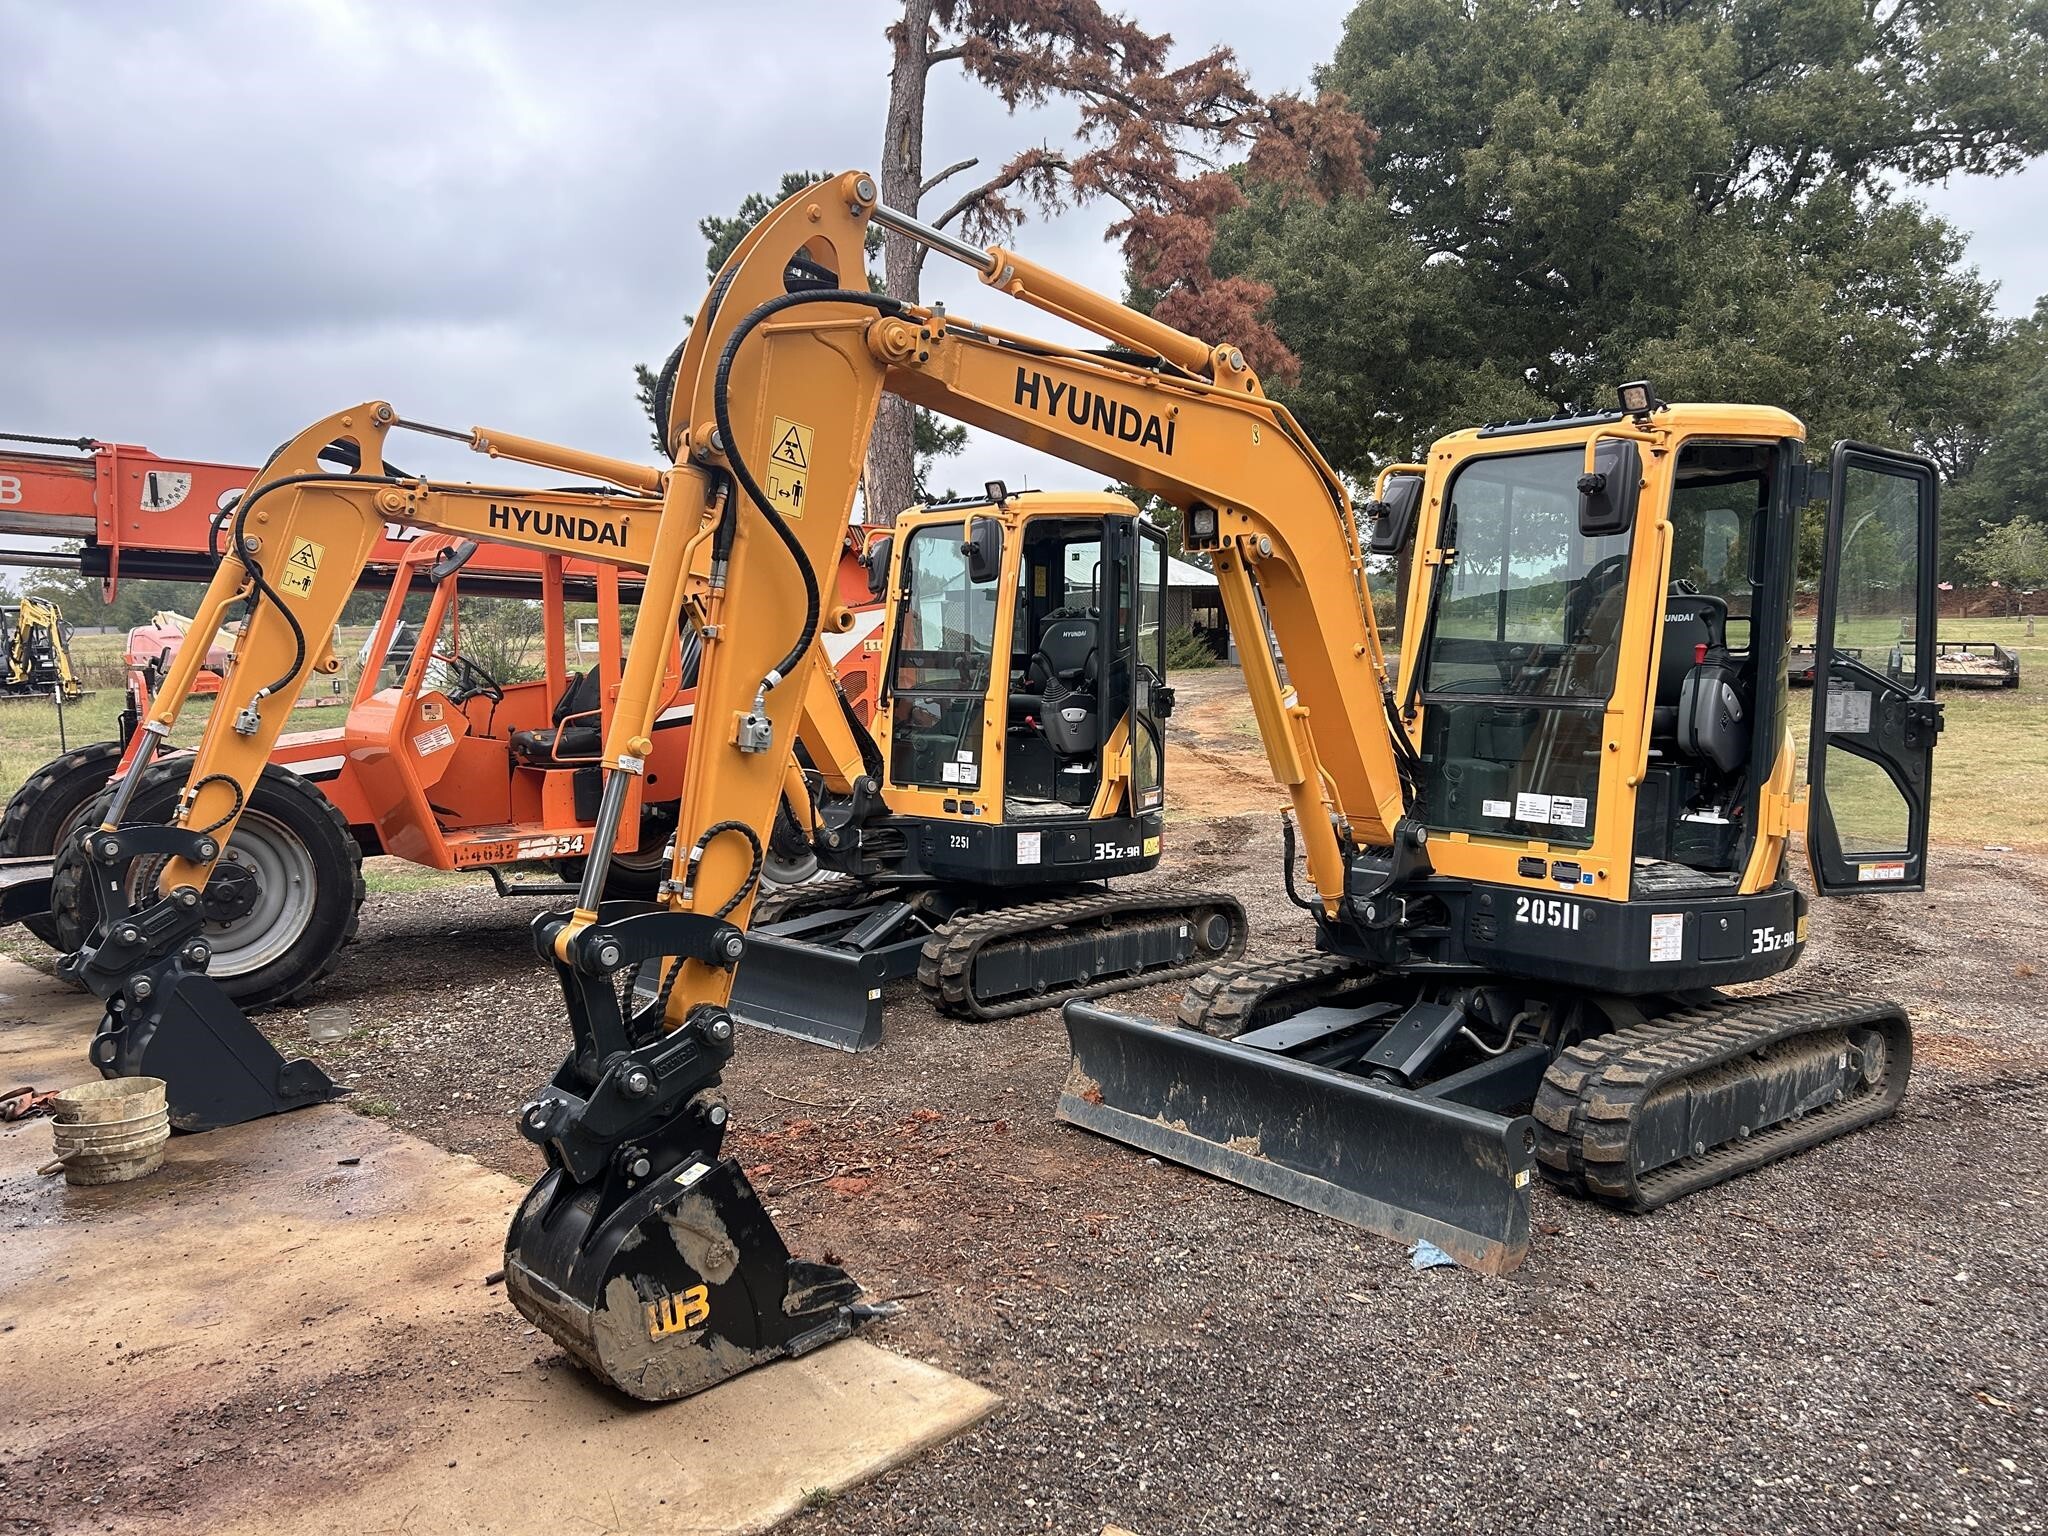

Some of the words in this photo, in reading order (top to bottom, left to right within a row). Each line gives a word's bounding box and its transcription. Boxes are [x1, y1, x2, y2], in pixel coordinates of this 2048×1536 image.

[1014, 366, 1175, 456] HYUNDAI
[489, 504, 627, 548] HYUNDAI
[1664, 613, 1694, 622] UNDAI
[865, 641, 883, 651] 11
[1515, 896, 1580, 931] 20511
